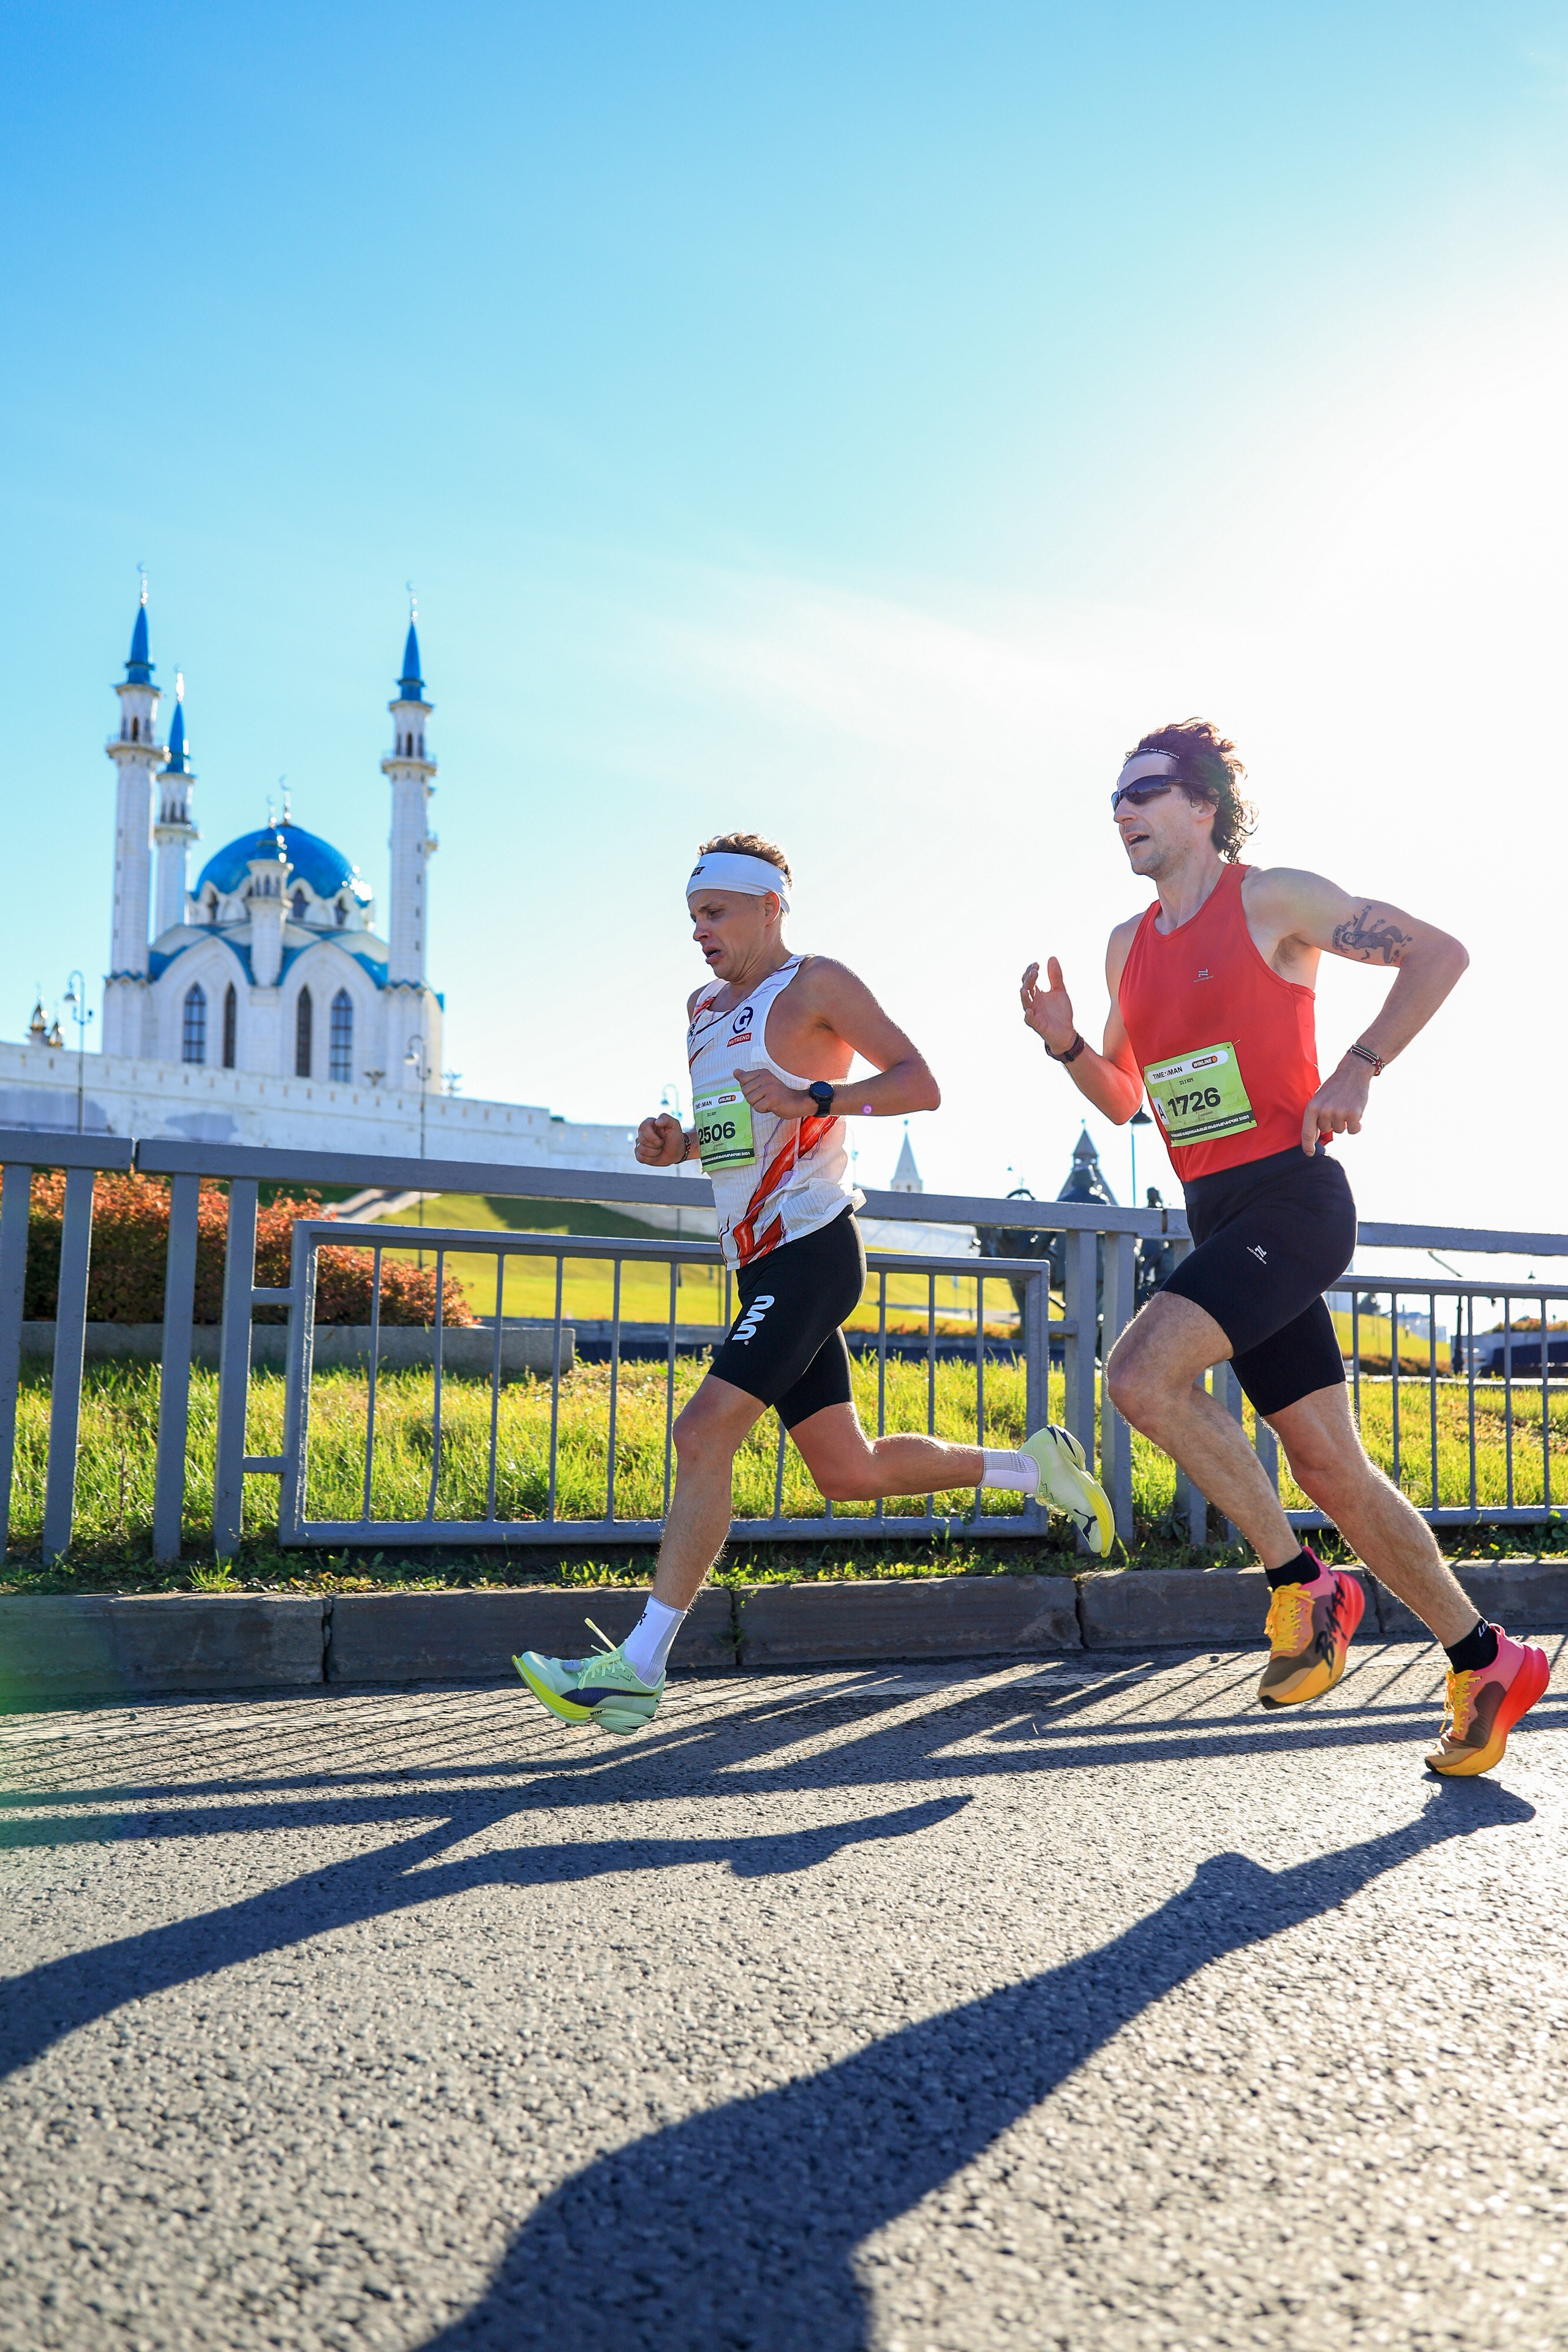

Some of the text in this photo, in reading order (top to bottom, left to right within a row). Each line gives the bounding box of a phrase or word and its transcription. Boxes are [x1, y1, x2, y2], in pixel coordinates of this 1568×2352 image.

[1158, 749, 1180, 760] БЕГОМ
[728, 1035, 750, 1046] NUTREND
[1193, 1058, 1212, 1068] WINLINE
[1167, 1087, 1221, 1117] 1726
[1156, 1103, 1166, 1120] A
[698, 1121, 736, 1145] 2506
